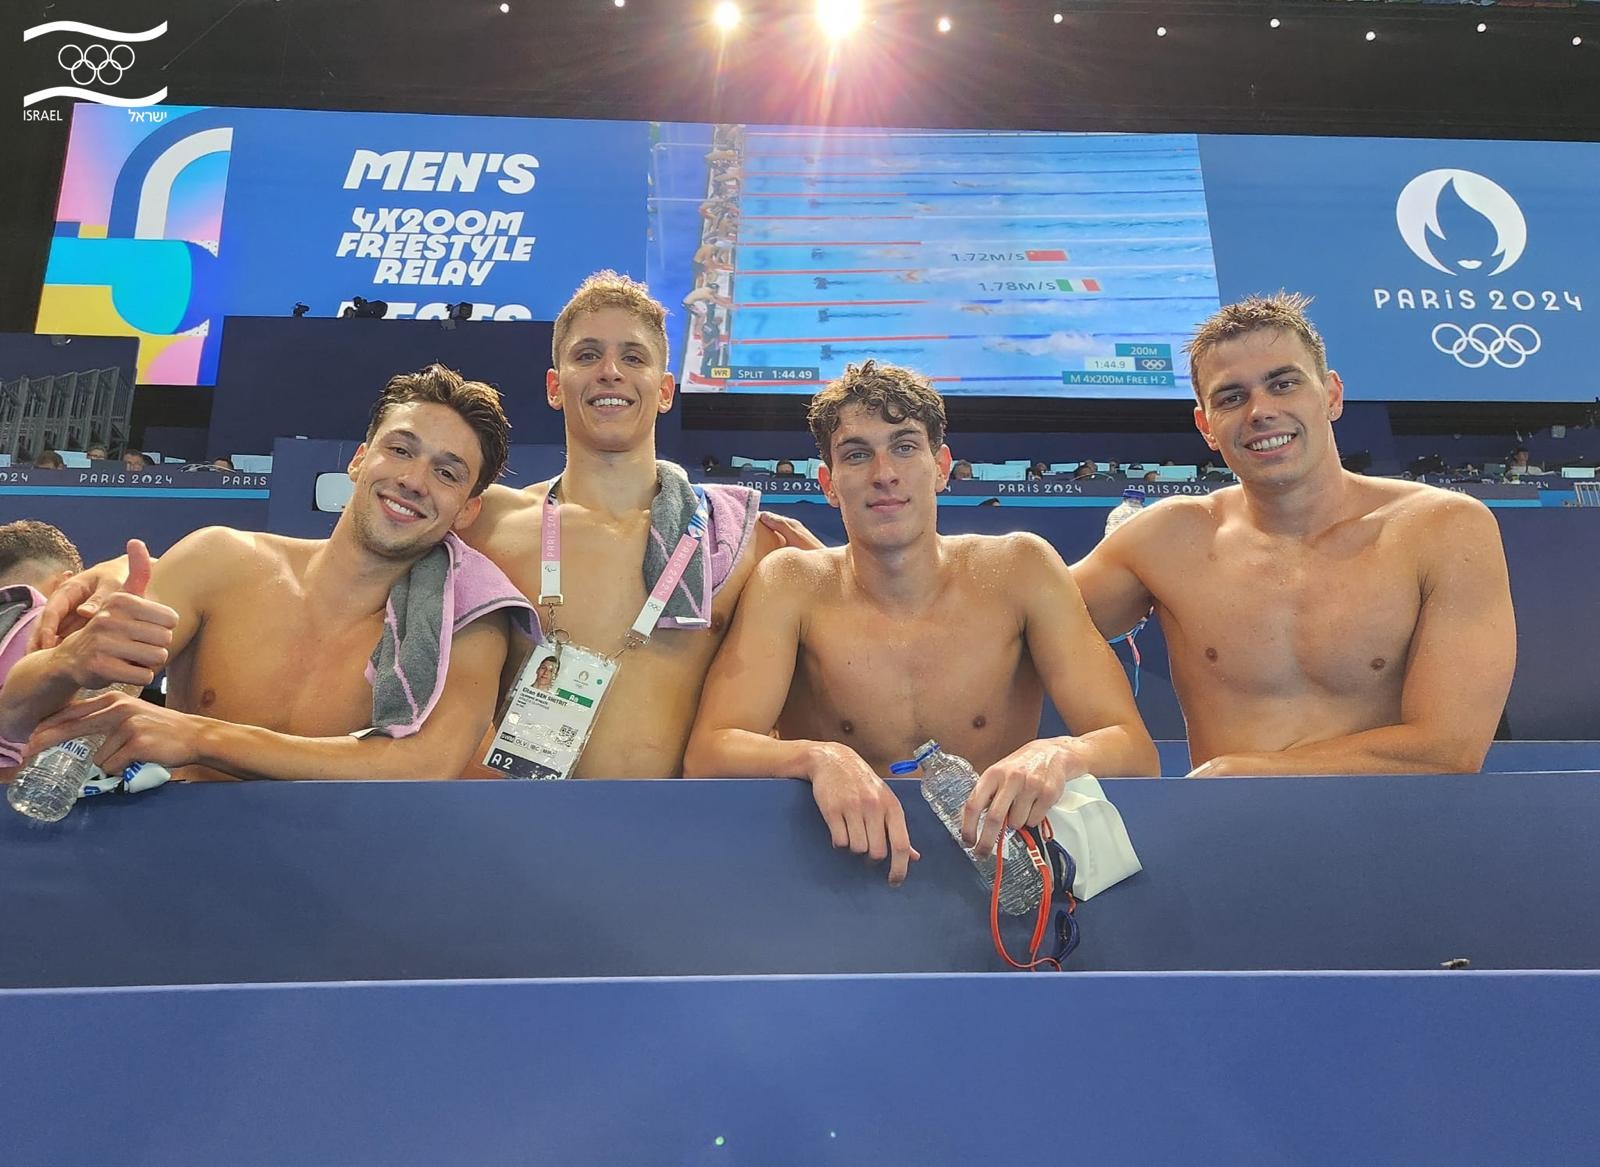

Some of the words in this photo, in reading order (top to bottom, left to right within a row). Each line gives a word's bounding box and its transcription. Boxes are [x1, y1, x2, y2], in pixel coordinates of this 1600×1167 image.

[342, 149, 540, 195] MEN'S
[351, 206, 525, 236] 4X200M
[335, 231, 536, 262] FREESTYLE
[951, 252, 1025, 262] 1.72M/S
[372, 258, 496, 286] RELAY
[978, 281, 1056, 292] 1.78M/S
[1488, 289, 1583, 312] 2024
[1094, 360, 1126, 369] 1:44.9
[713, 368, 728, 377] WR
[738, 369, 764, 379] SPLIT
[772, 370, 813, 379] 1:44.49
[1070, 374, 1080, 383] M
[1126, 376, 1149, 385] FREE
[1150, 376, 1158, 385] H
[1160, 376, 1167, 385] 2
[0, 472, 29, 482] 024
[79, 473, 126, 483] PARIS
[131, 474, 173, 484] 2024
[222, 475, 268, 486] PARIS
[783, 481, 820, 491] 2024
[998, 483, 1039, 494] PARIS
[1044, 484, 1082, 494] 2024
[1173, 485, 1210, 494] 2024
[502, 757, 513, 770] 2
